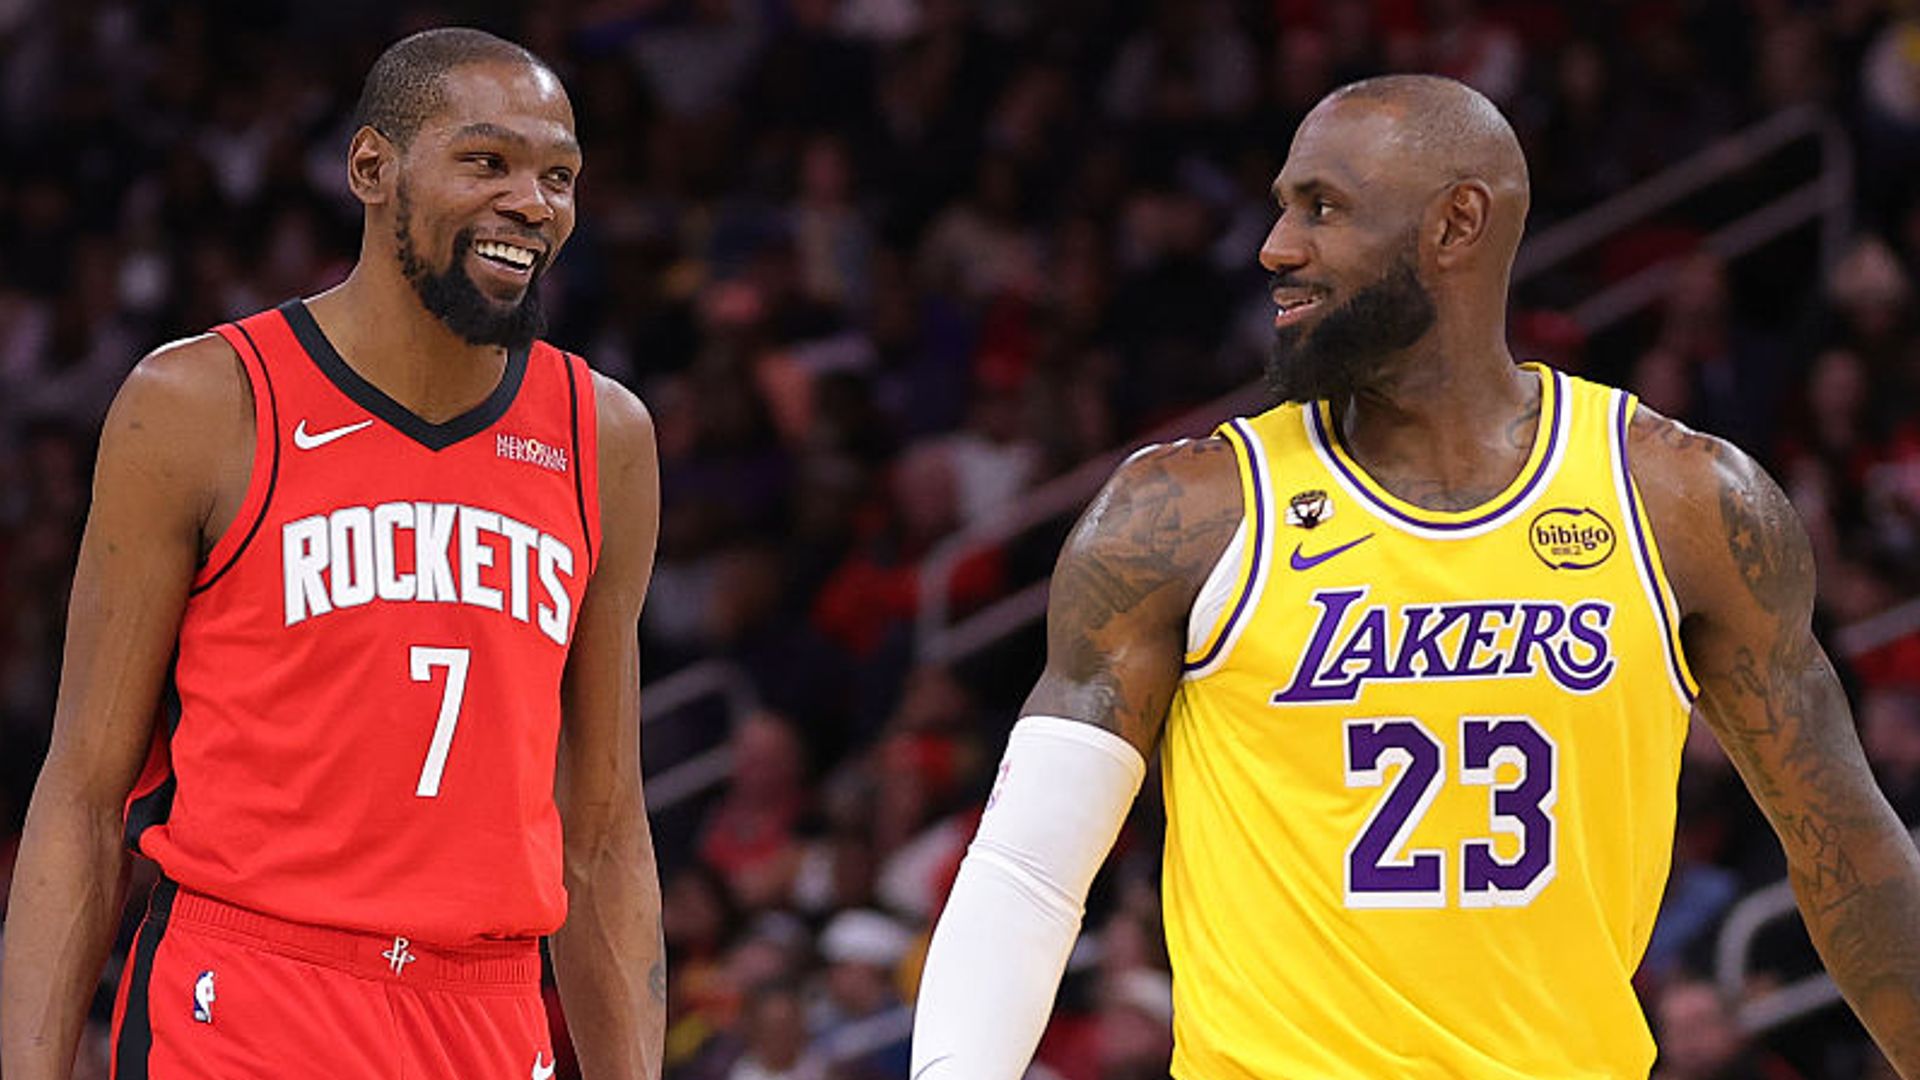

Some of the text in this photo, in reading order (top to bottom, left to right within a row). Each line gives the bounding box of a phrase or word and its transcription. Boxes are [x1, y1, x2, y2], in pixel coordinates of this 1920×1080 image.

[283, 501, 574, 646] ROCKETS
[1536, 523, 1609, 550] bibigo
[1271, 587, 1618, 704] LAKERS
[410, 645, 470, 797] 7
[1344, 716, 1557, 907] 23
